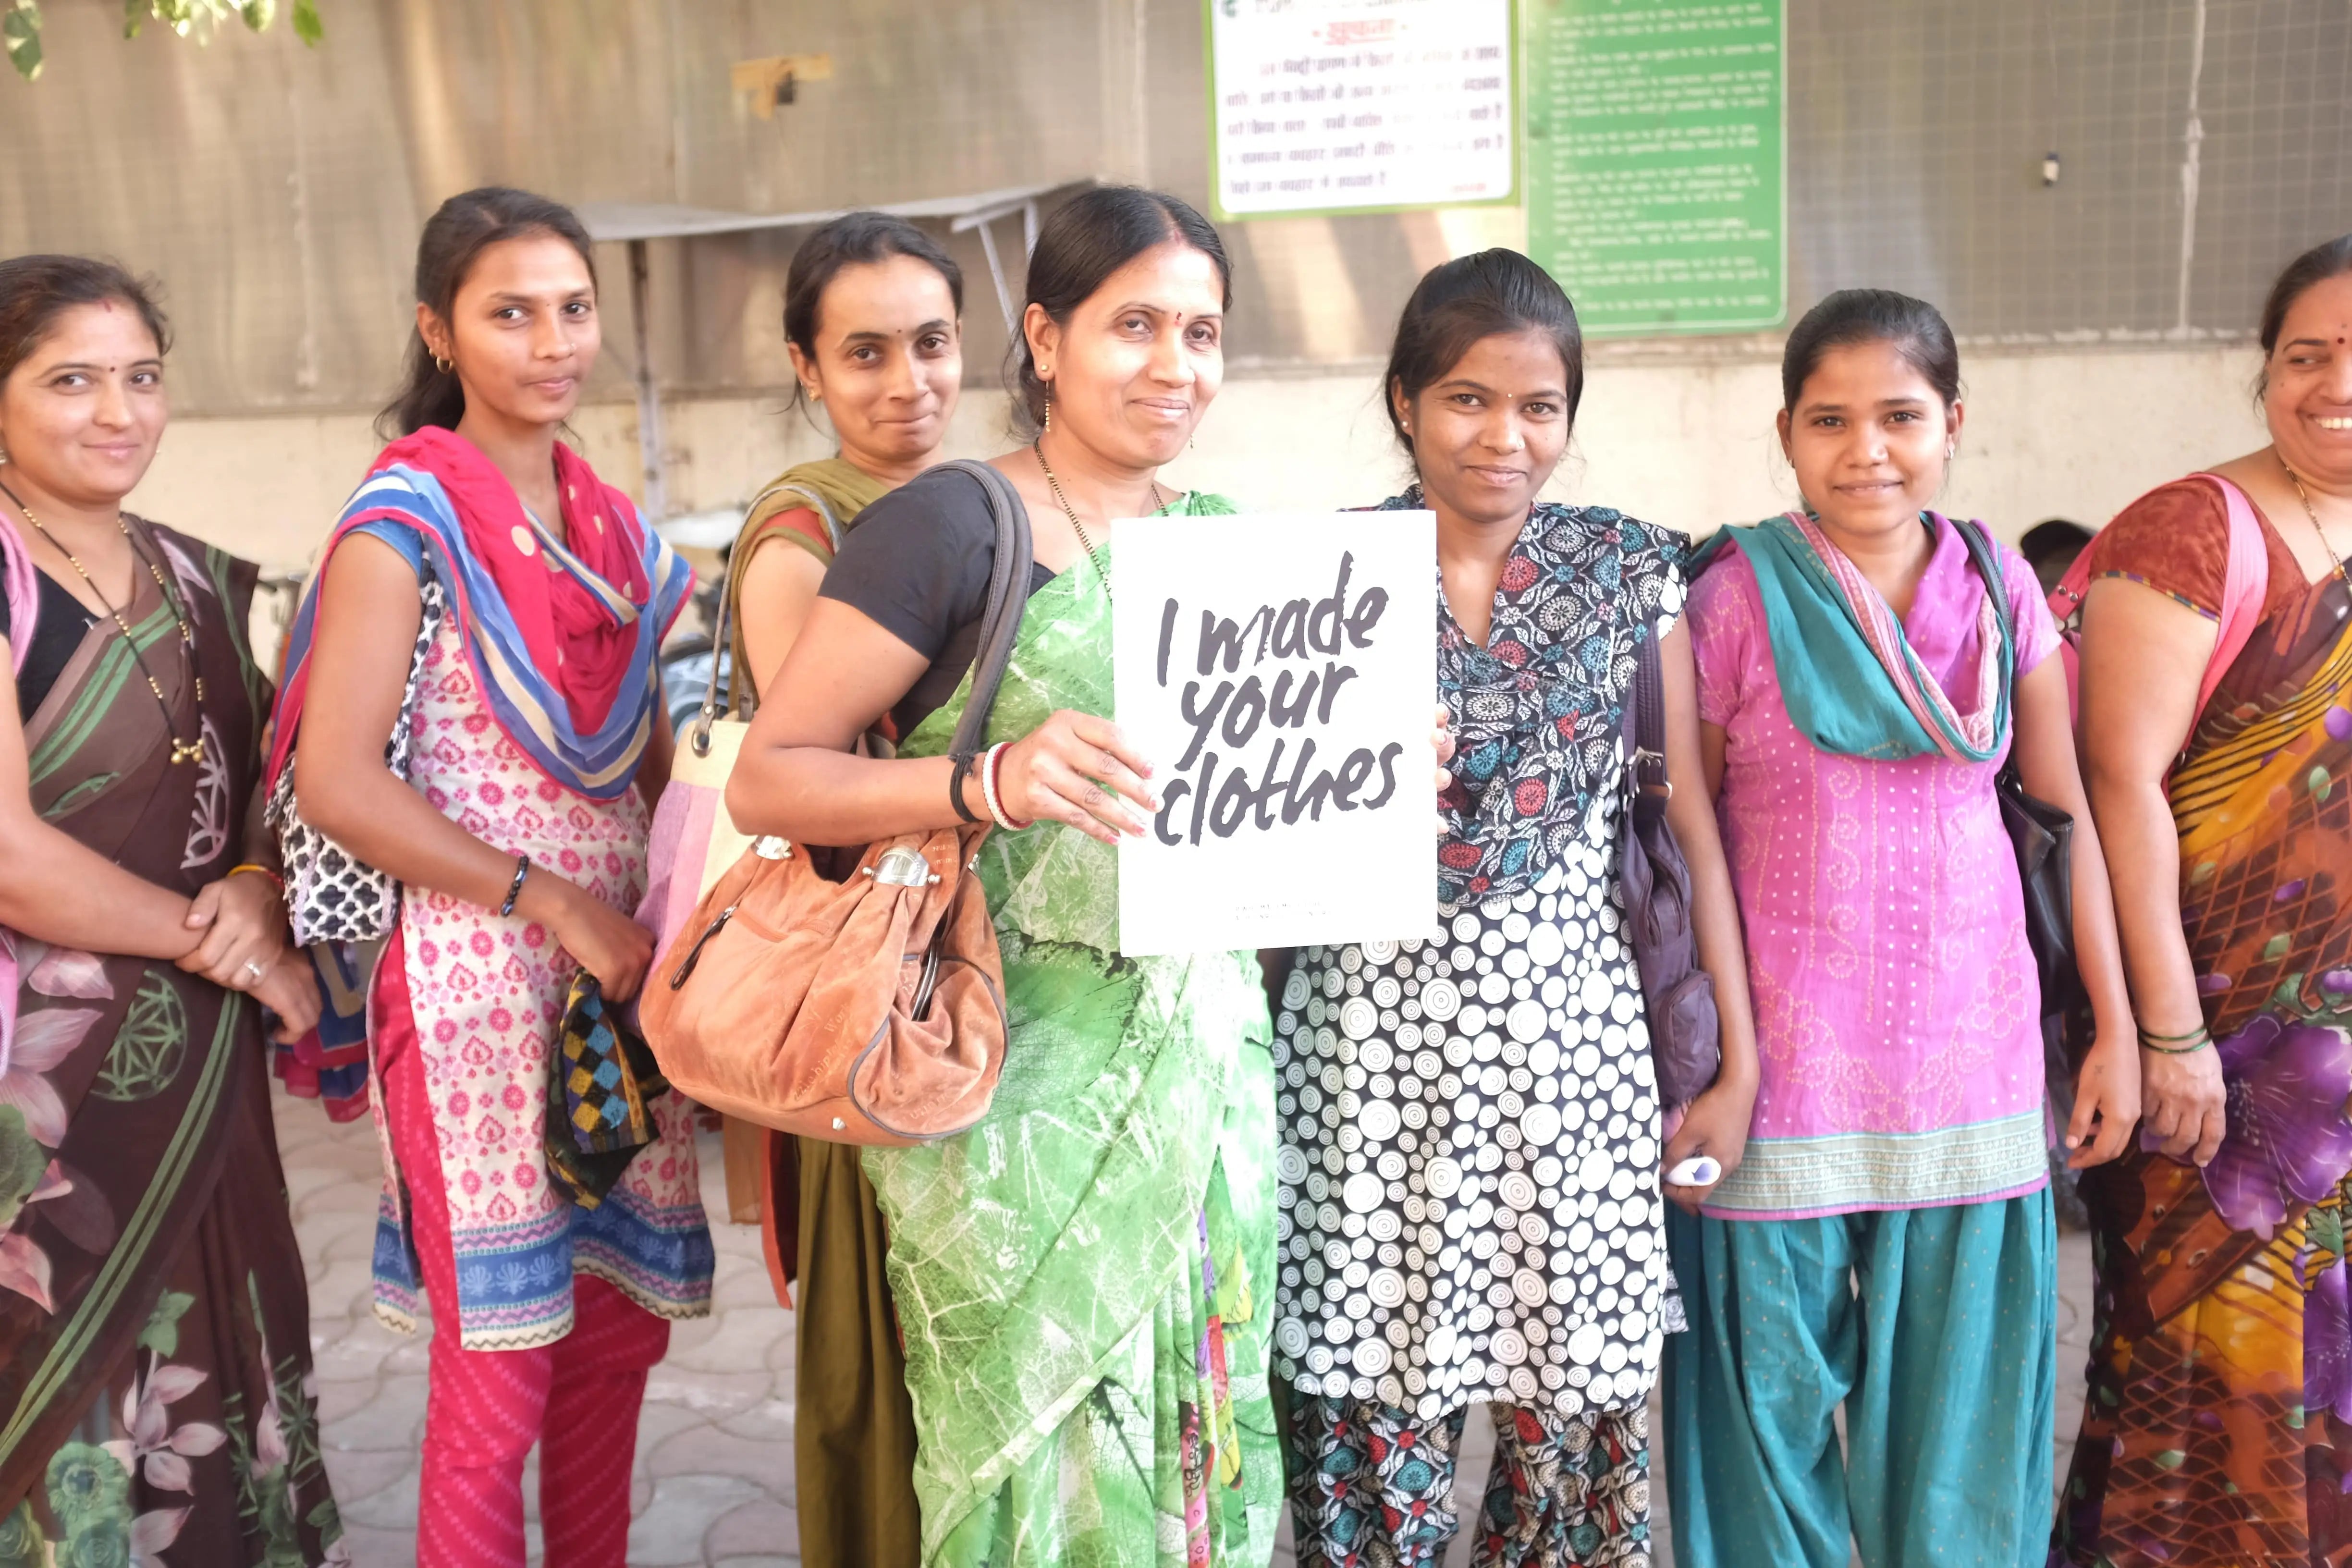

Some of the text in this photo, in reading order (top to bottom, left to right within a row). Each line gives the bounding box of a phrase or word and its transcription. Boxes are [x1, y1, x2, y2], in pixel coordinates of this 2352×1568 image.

[1157, 551, 1389, 687] I made
[1175, 662, 1359, 771] your
[1154, 738, 1403, 846] clothes
